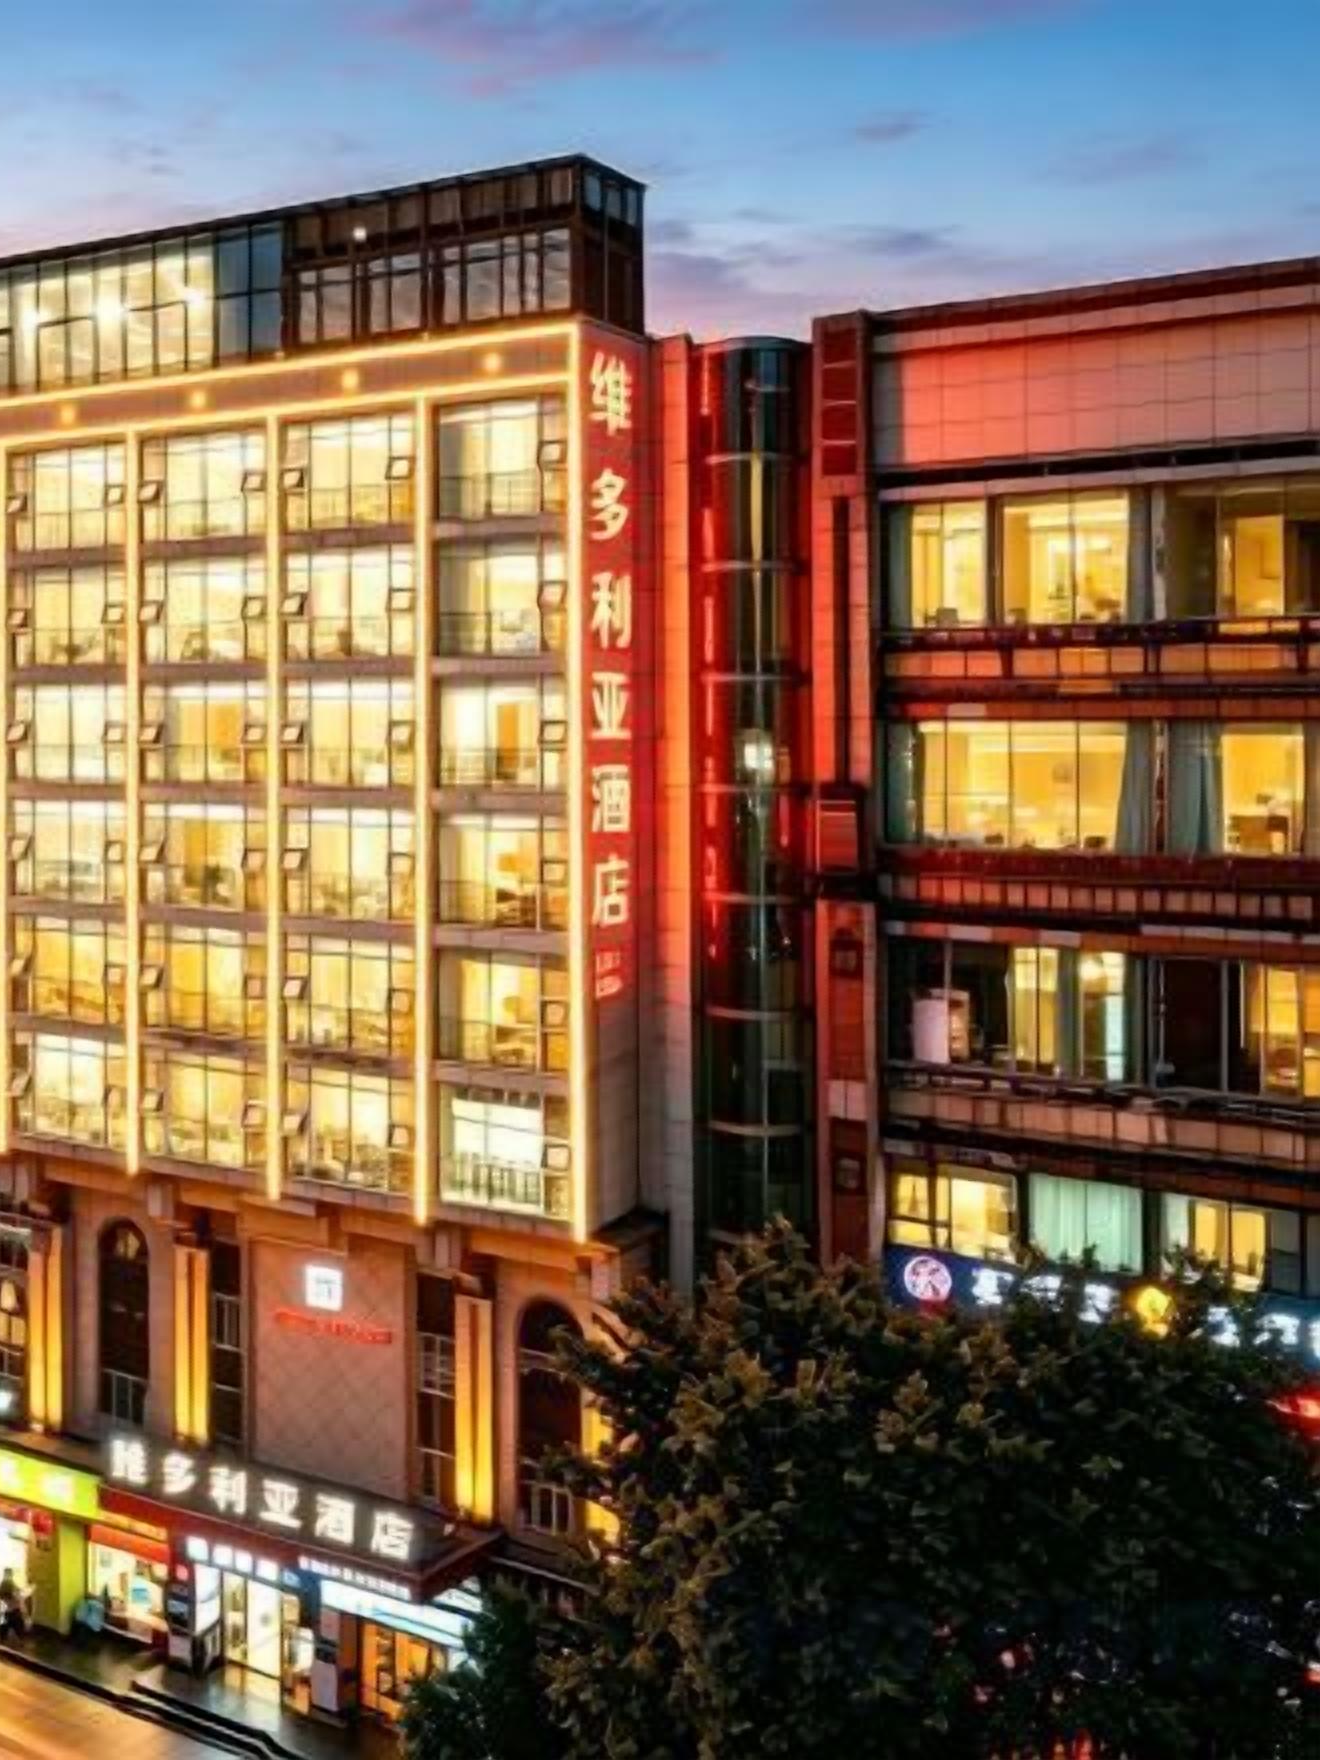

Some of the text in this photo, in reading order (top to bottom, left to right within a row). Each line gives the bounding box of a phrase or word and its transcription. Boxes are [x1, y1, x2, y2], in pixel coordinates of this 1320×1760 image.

[588, 350, 633, 928] 维多利亚酒店
